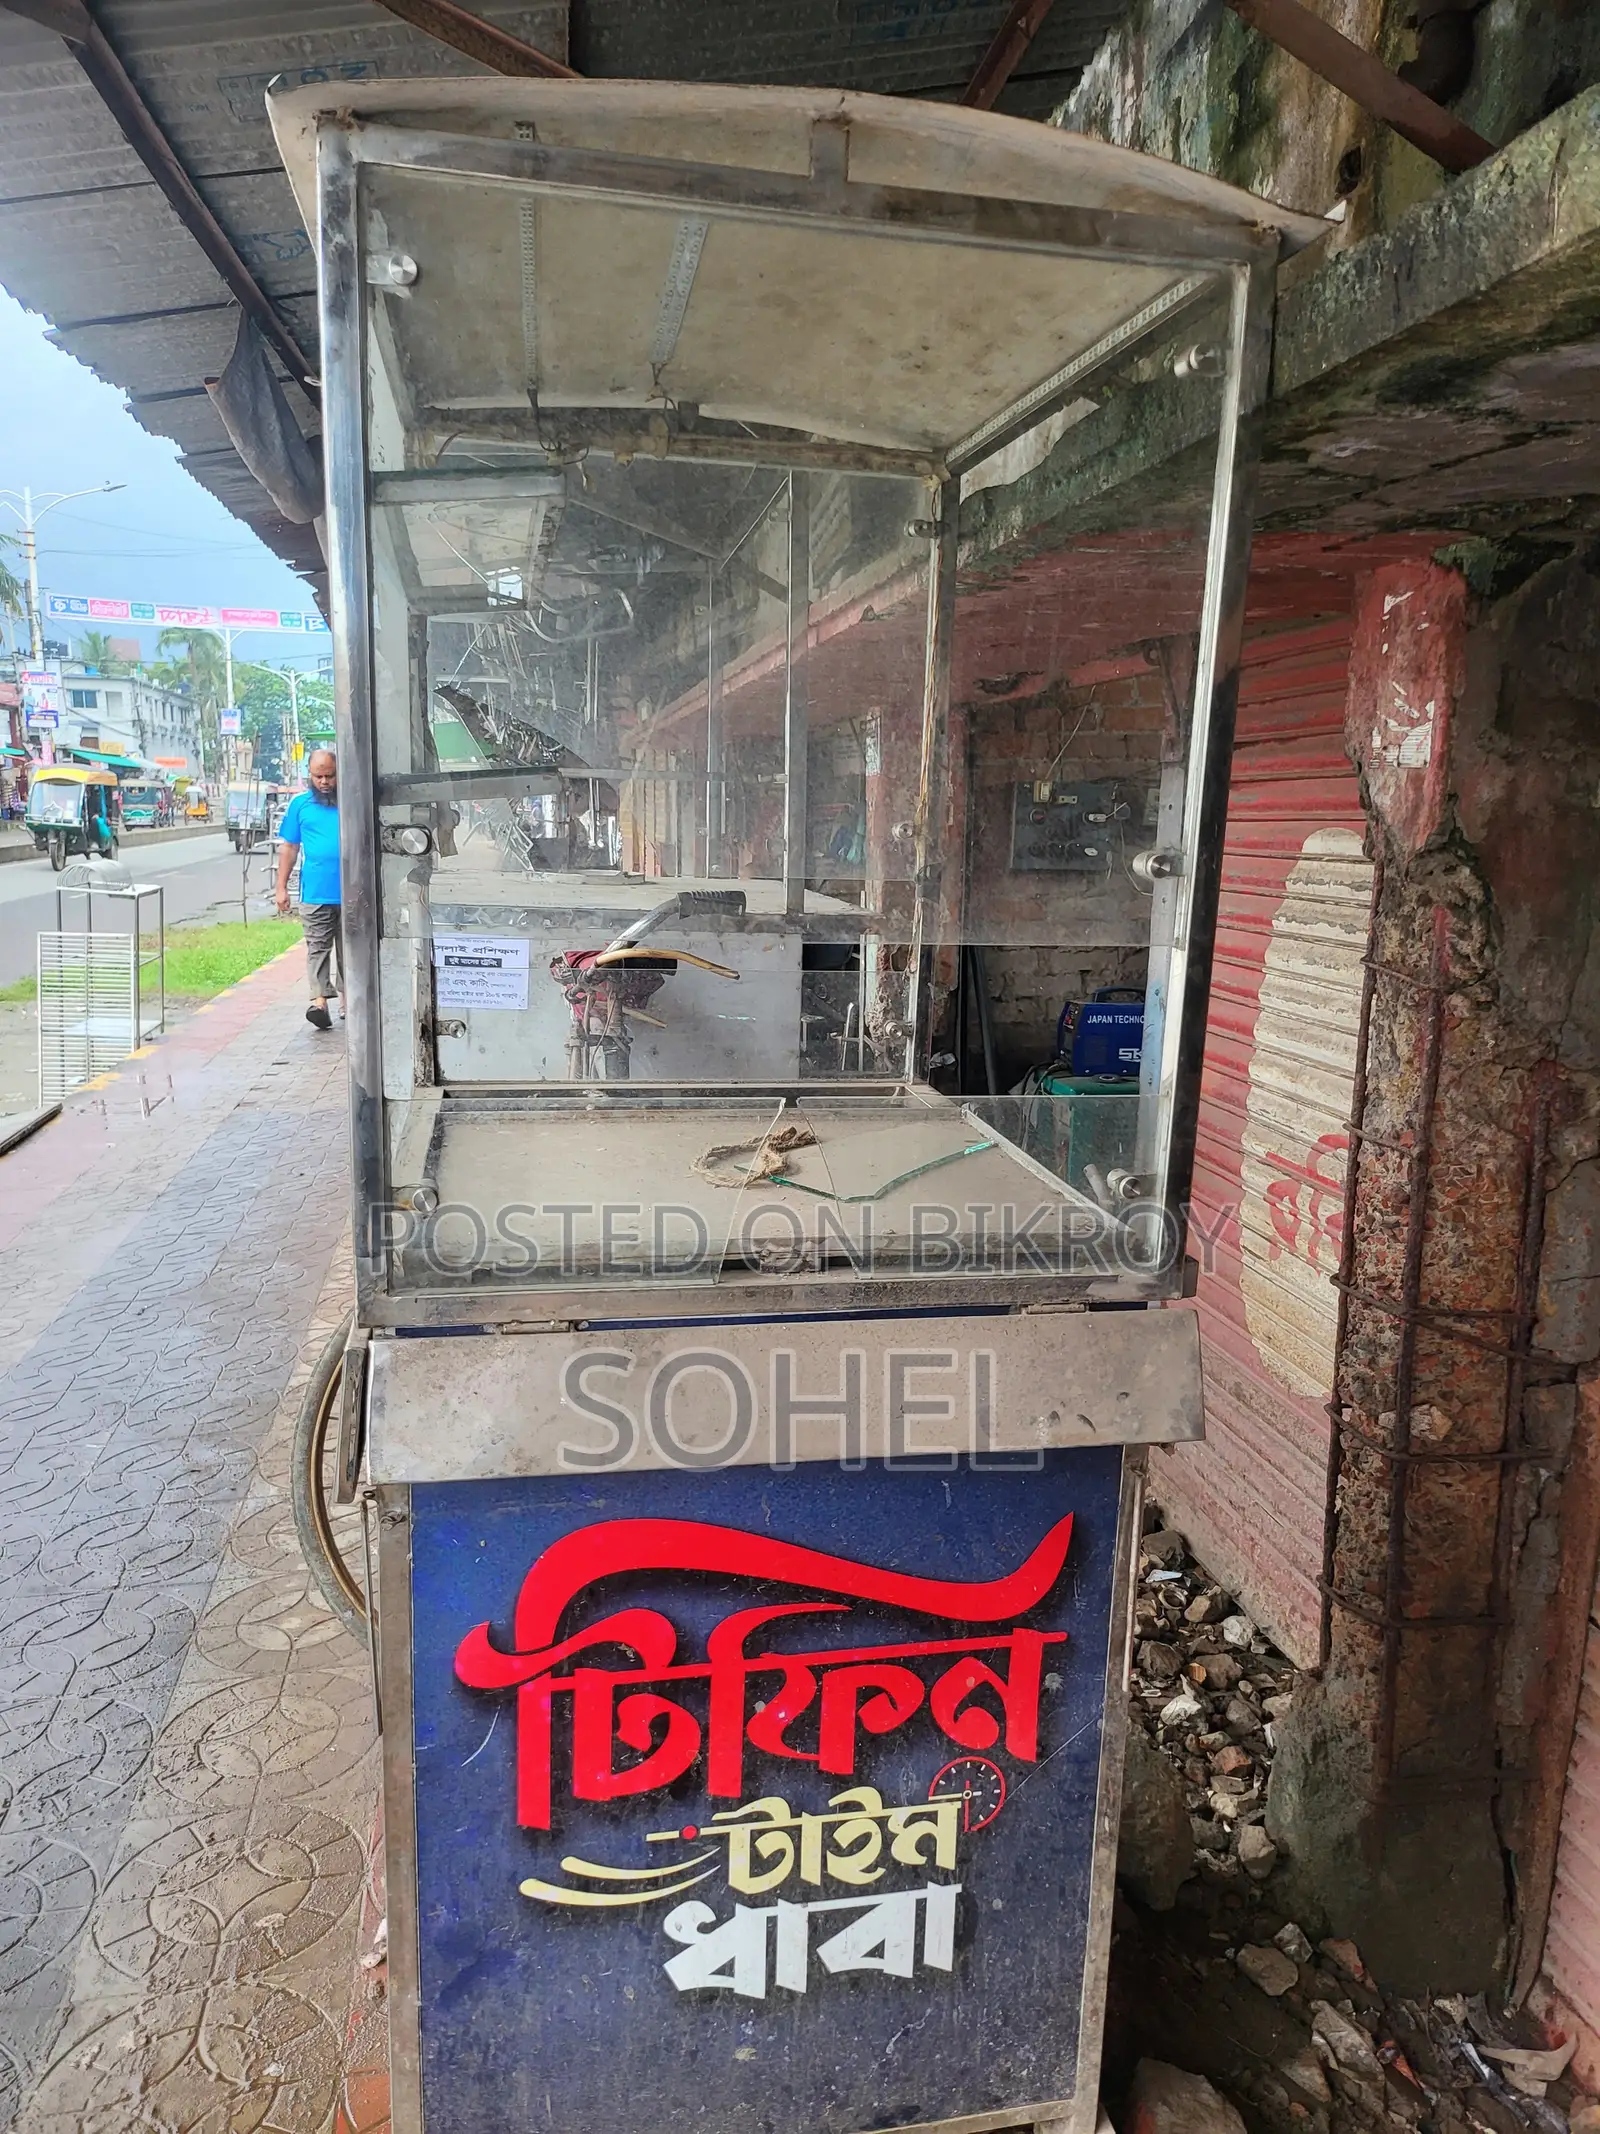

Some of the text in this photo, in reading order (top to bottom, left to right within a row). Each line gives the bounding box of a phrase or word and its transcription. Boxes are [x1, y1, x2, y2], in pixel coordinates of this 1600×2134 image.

[434, 944, 519, 955] সলাই প্রশিক্ষণ
[1087, 1015, 1113, 1024] JAPAN
[455, 1512, 1074, 1830] টিফিন
[700, 1786, 962, 1894] টাইম
[663, 1882, 962, 1999] ধাবা
